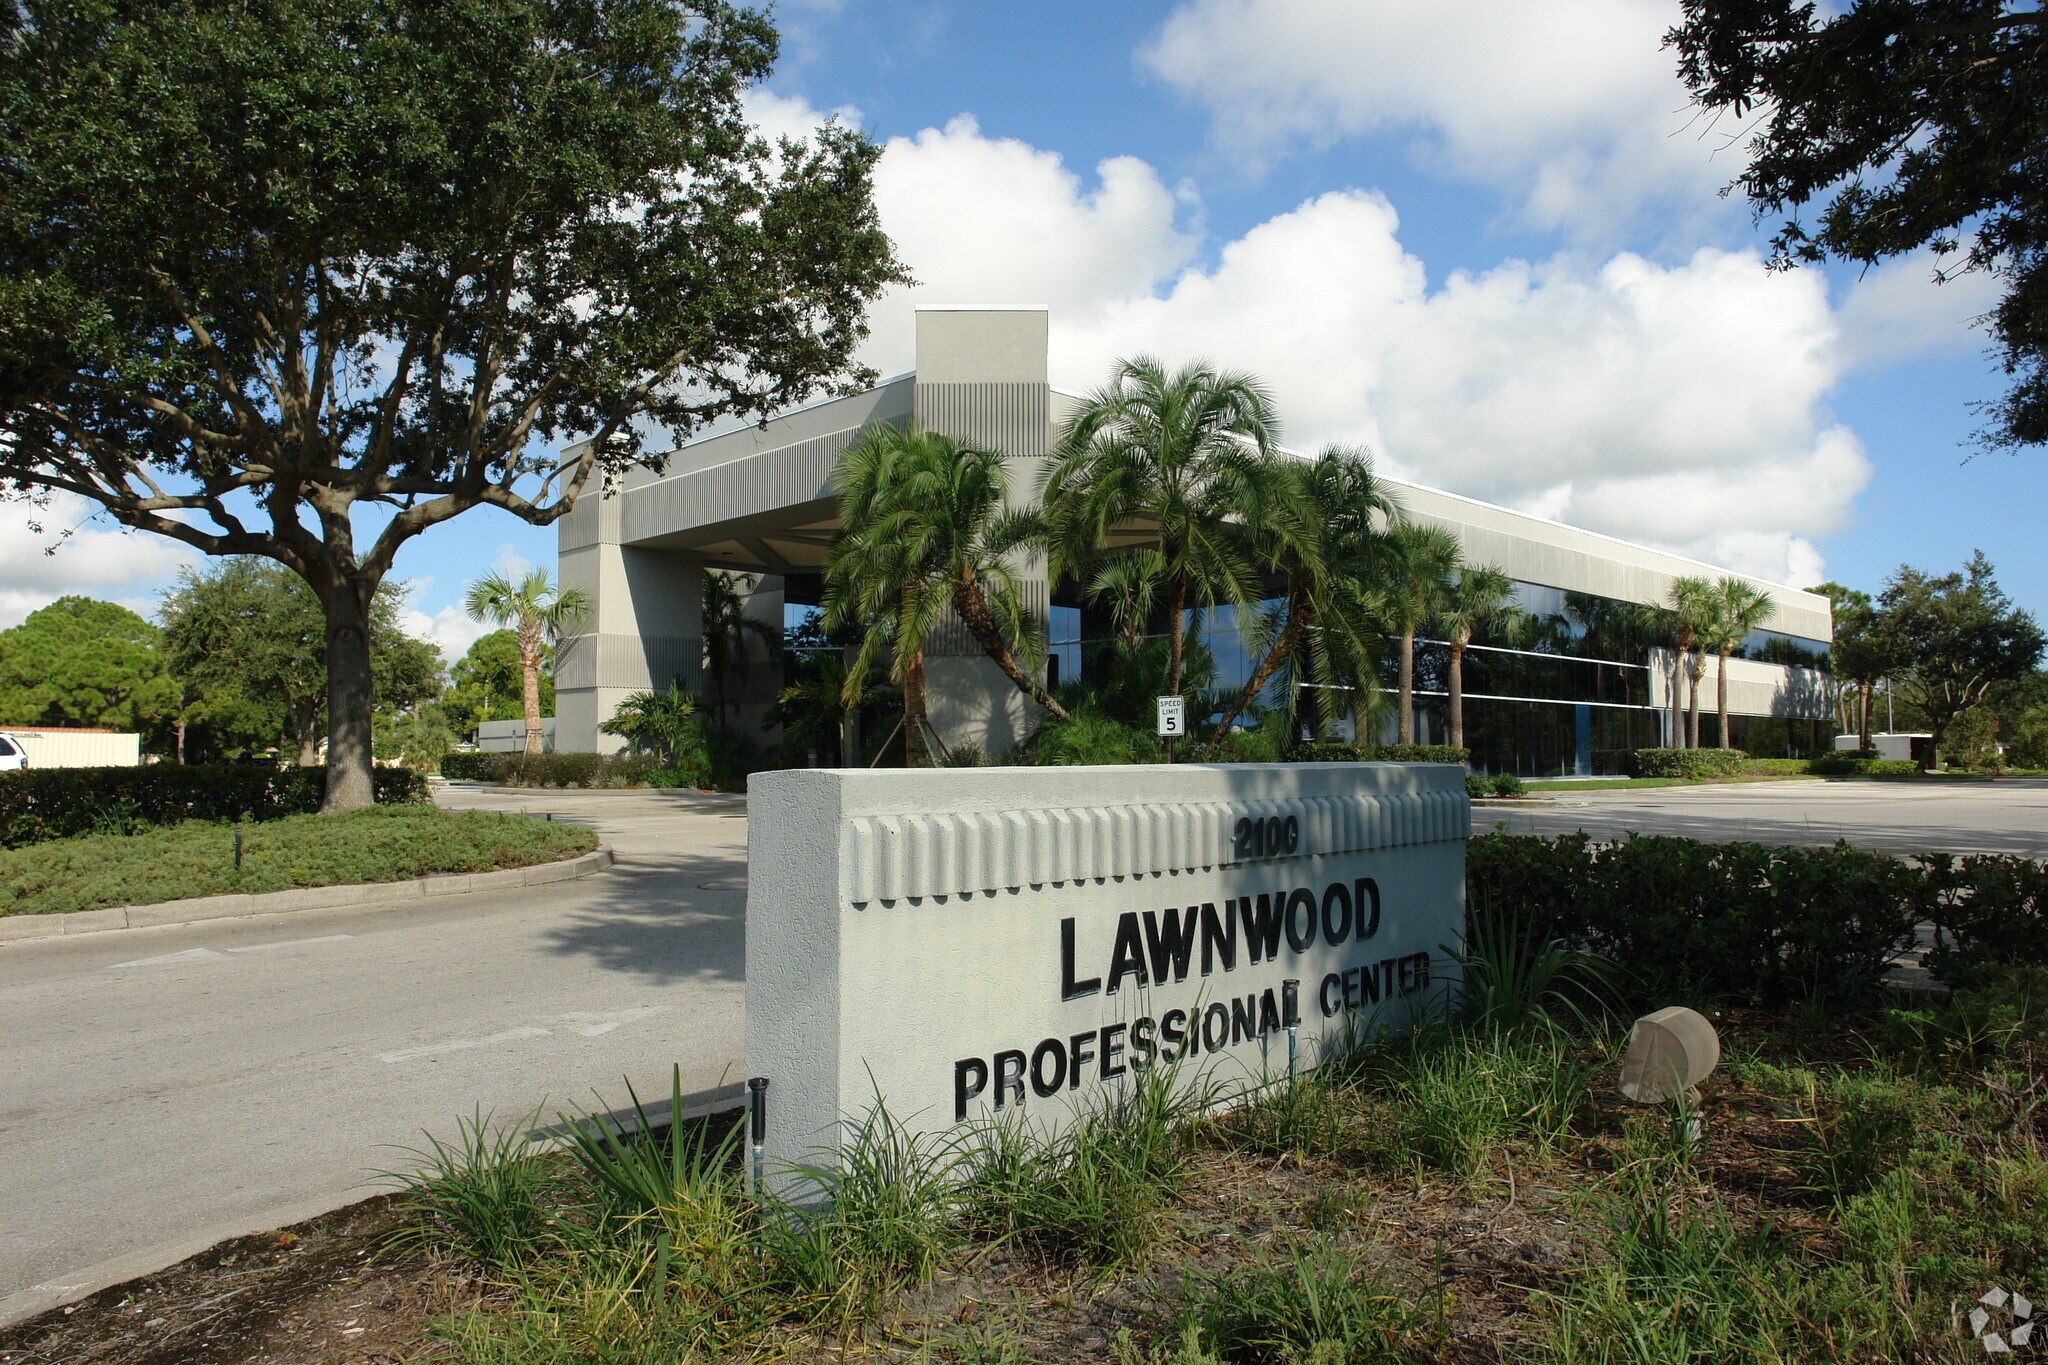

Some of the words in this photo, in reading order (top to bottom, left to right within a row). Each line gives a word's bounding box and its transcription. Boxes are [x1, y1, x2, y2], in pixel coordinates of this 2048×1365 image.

[1166, 717, 1176, 731] 5
[1235, 815, 1299, 858] 2100
[1060, 877, 1381, 1002] LAWNWOOD
[1320, 951, 1430, 1018] CENTER
